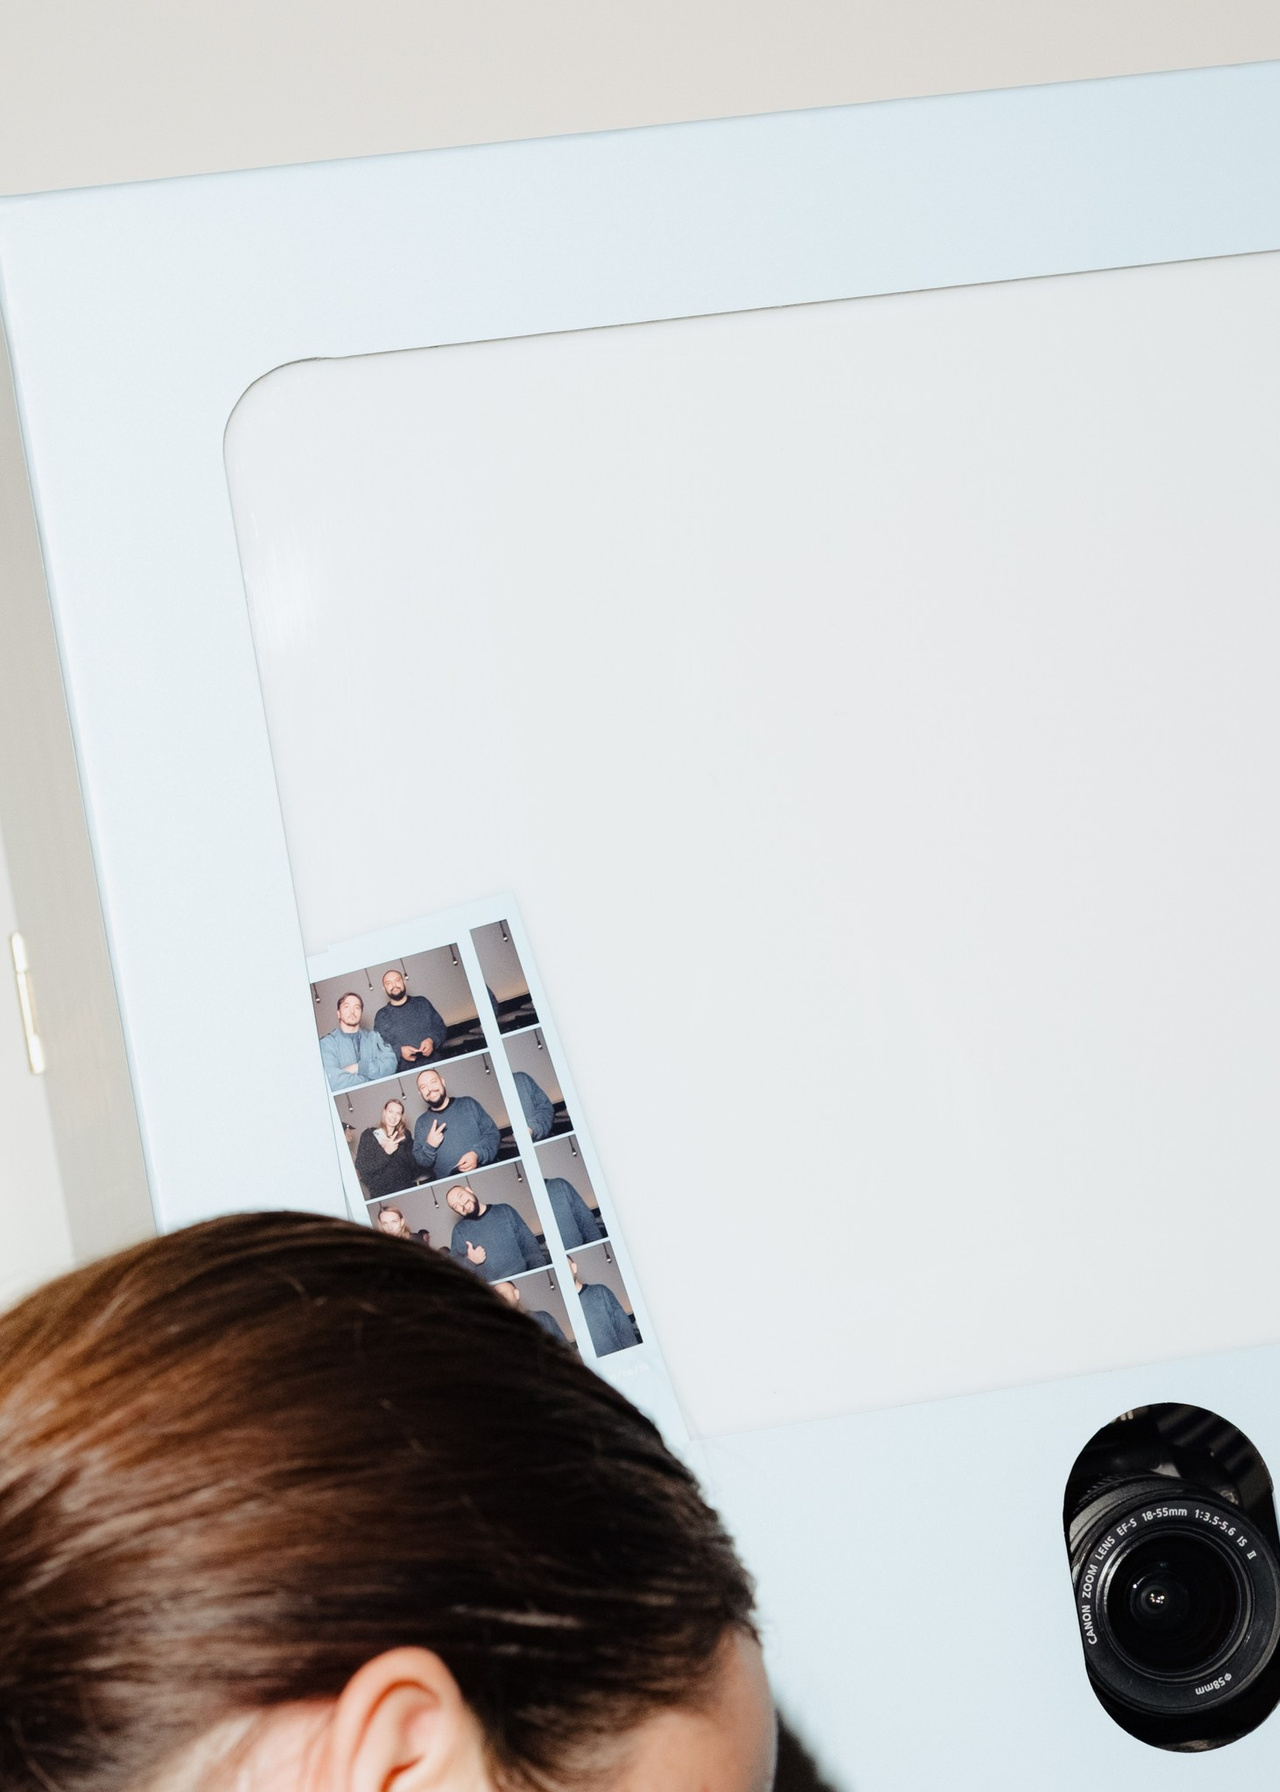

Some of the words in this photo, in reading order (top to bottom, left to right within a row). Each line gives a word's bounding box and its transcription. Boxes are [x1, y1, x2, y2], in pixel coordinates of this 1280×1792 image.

[1141, 1507, 1188, 1522] 18-55mm
[1116, 1517, 1138, 1537] EF-S
[1094, 1535, 1116, 1561] LENS
[1236, 1535, 1248, 1548] IS
[1081, 1563, 1099, 1599] ZOOM
[1081, 1604, 1098, 1645] CANON
